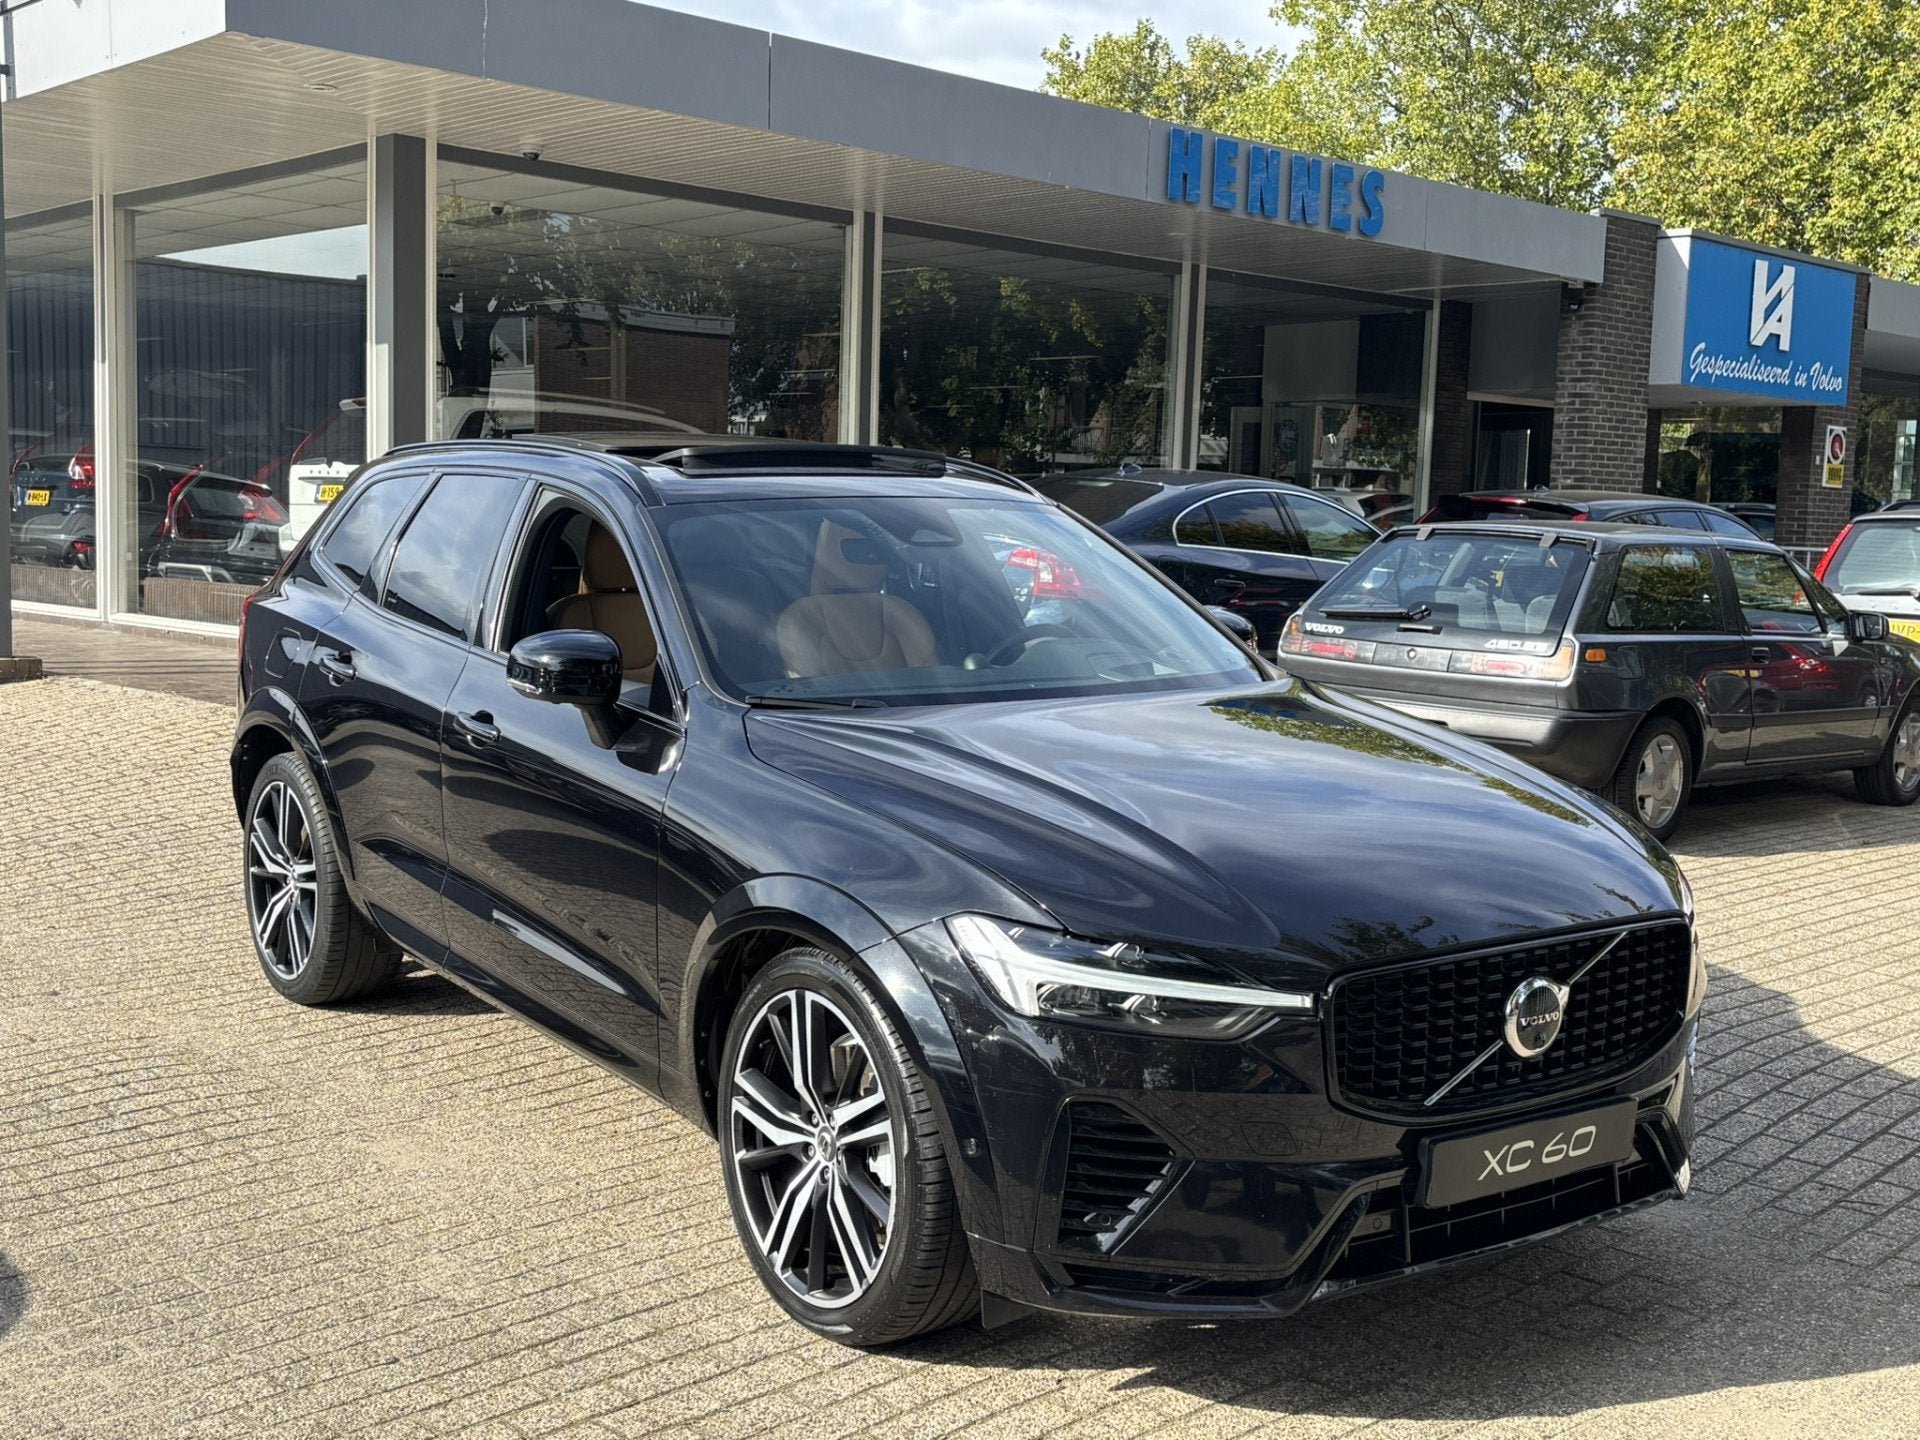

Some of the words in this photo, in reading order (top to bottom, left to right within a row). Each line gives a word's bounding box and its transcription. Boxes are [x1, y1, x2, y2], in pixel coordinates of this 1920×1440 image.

[1168, 127, 1384, 236] HENNES
[1689, 341, 1791, 384] Gespecialiseerd
[1795, 365, 1807, 388] in
[1809, 361, 1843, 392] Volvo
[1304, 622, 1345, 635] VOLVO
[1519, 1010, 1561, 1027] VOLVO
[1477, 1139, 1535, 1181] XC
[1541, 1125, 1597, 1164] 60
